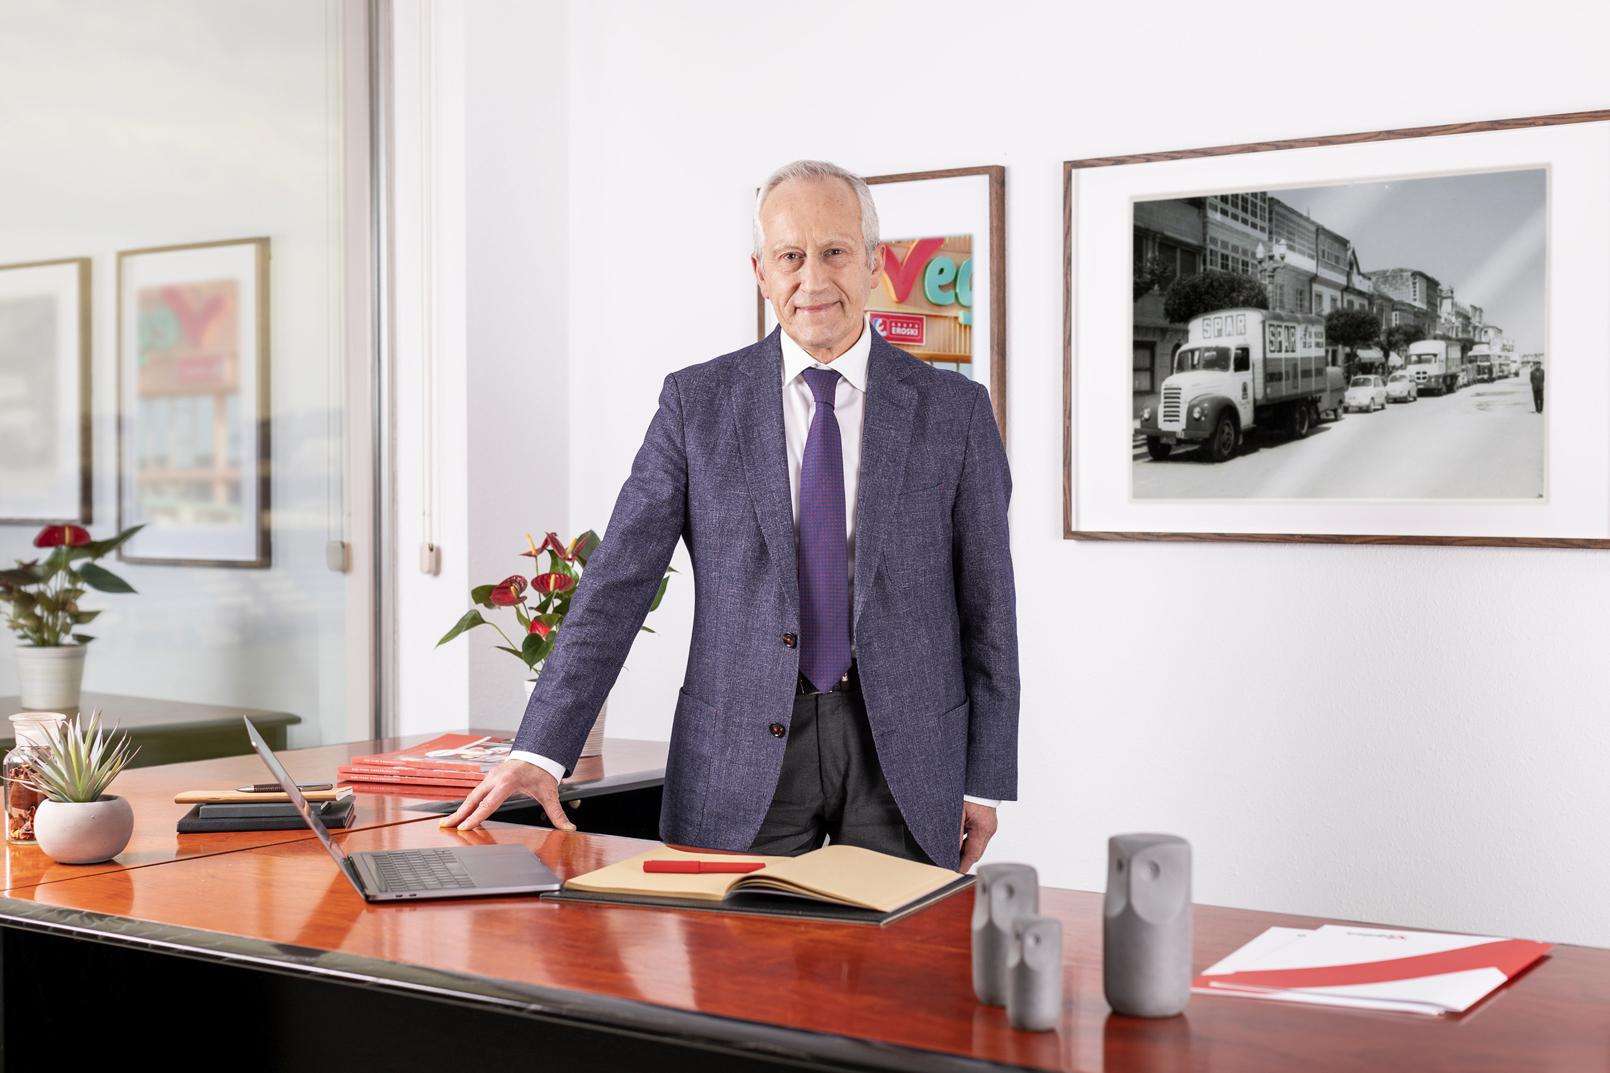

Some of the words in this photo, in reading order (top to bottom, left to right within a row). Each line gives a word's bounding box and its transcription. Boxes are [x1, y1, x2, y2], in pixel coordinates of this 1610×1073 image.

[891, 327, 919, 336] EROSKI
[1202, 314, 1246, 339] SPAR
[1268, 323, 1297, 353] SPAR
